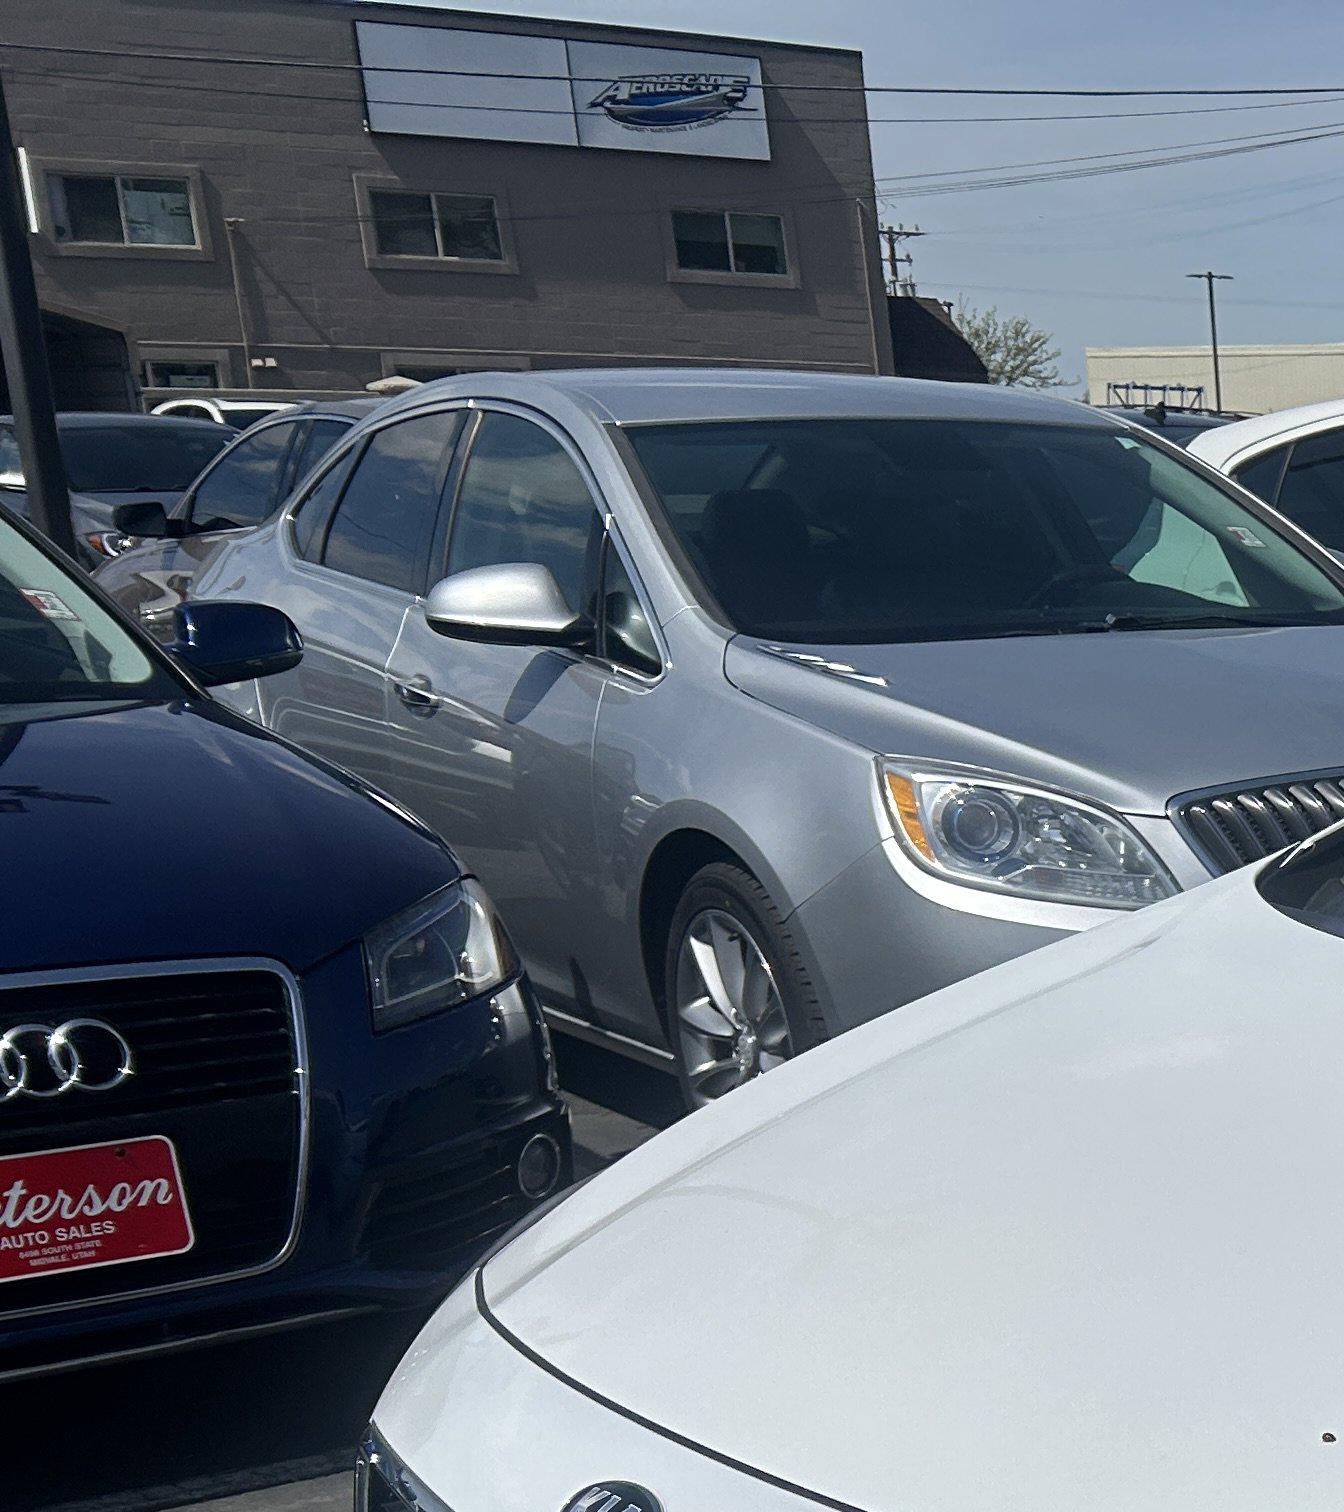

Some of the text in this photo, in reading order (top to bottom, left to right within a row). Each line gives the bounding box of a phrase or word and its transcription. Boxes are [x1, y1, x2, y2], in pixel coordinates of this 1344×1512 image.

[587, 74, 751, 107] AEROSCAPE
[0, 1178, 173, 1228] terson
[0, 1220, 115, 1249] AUTO SALES
